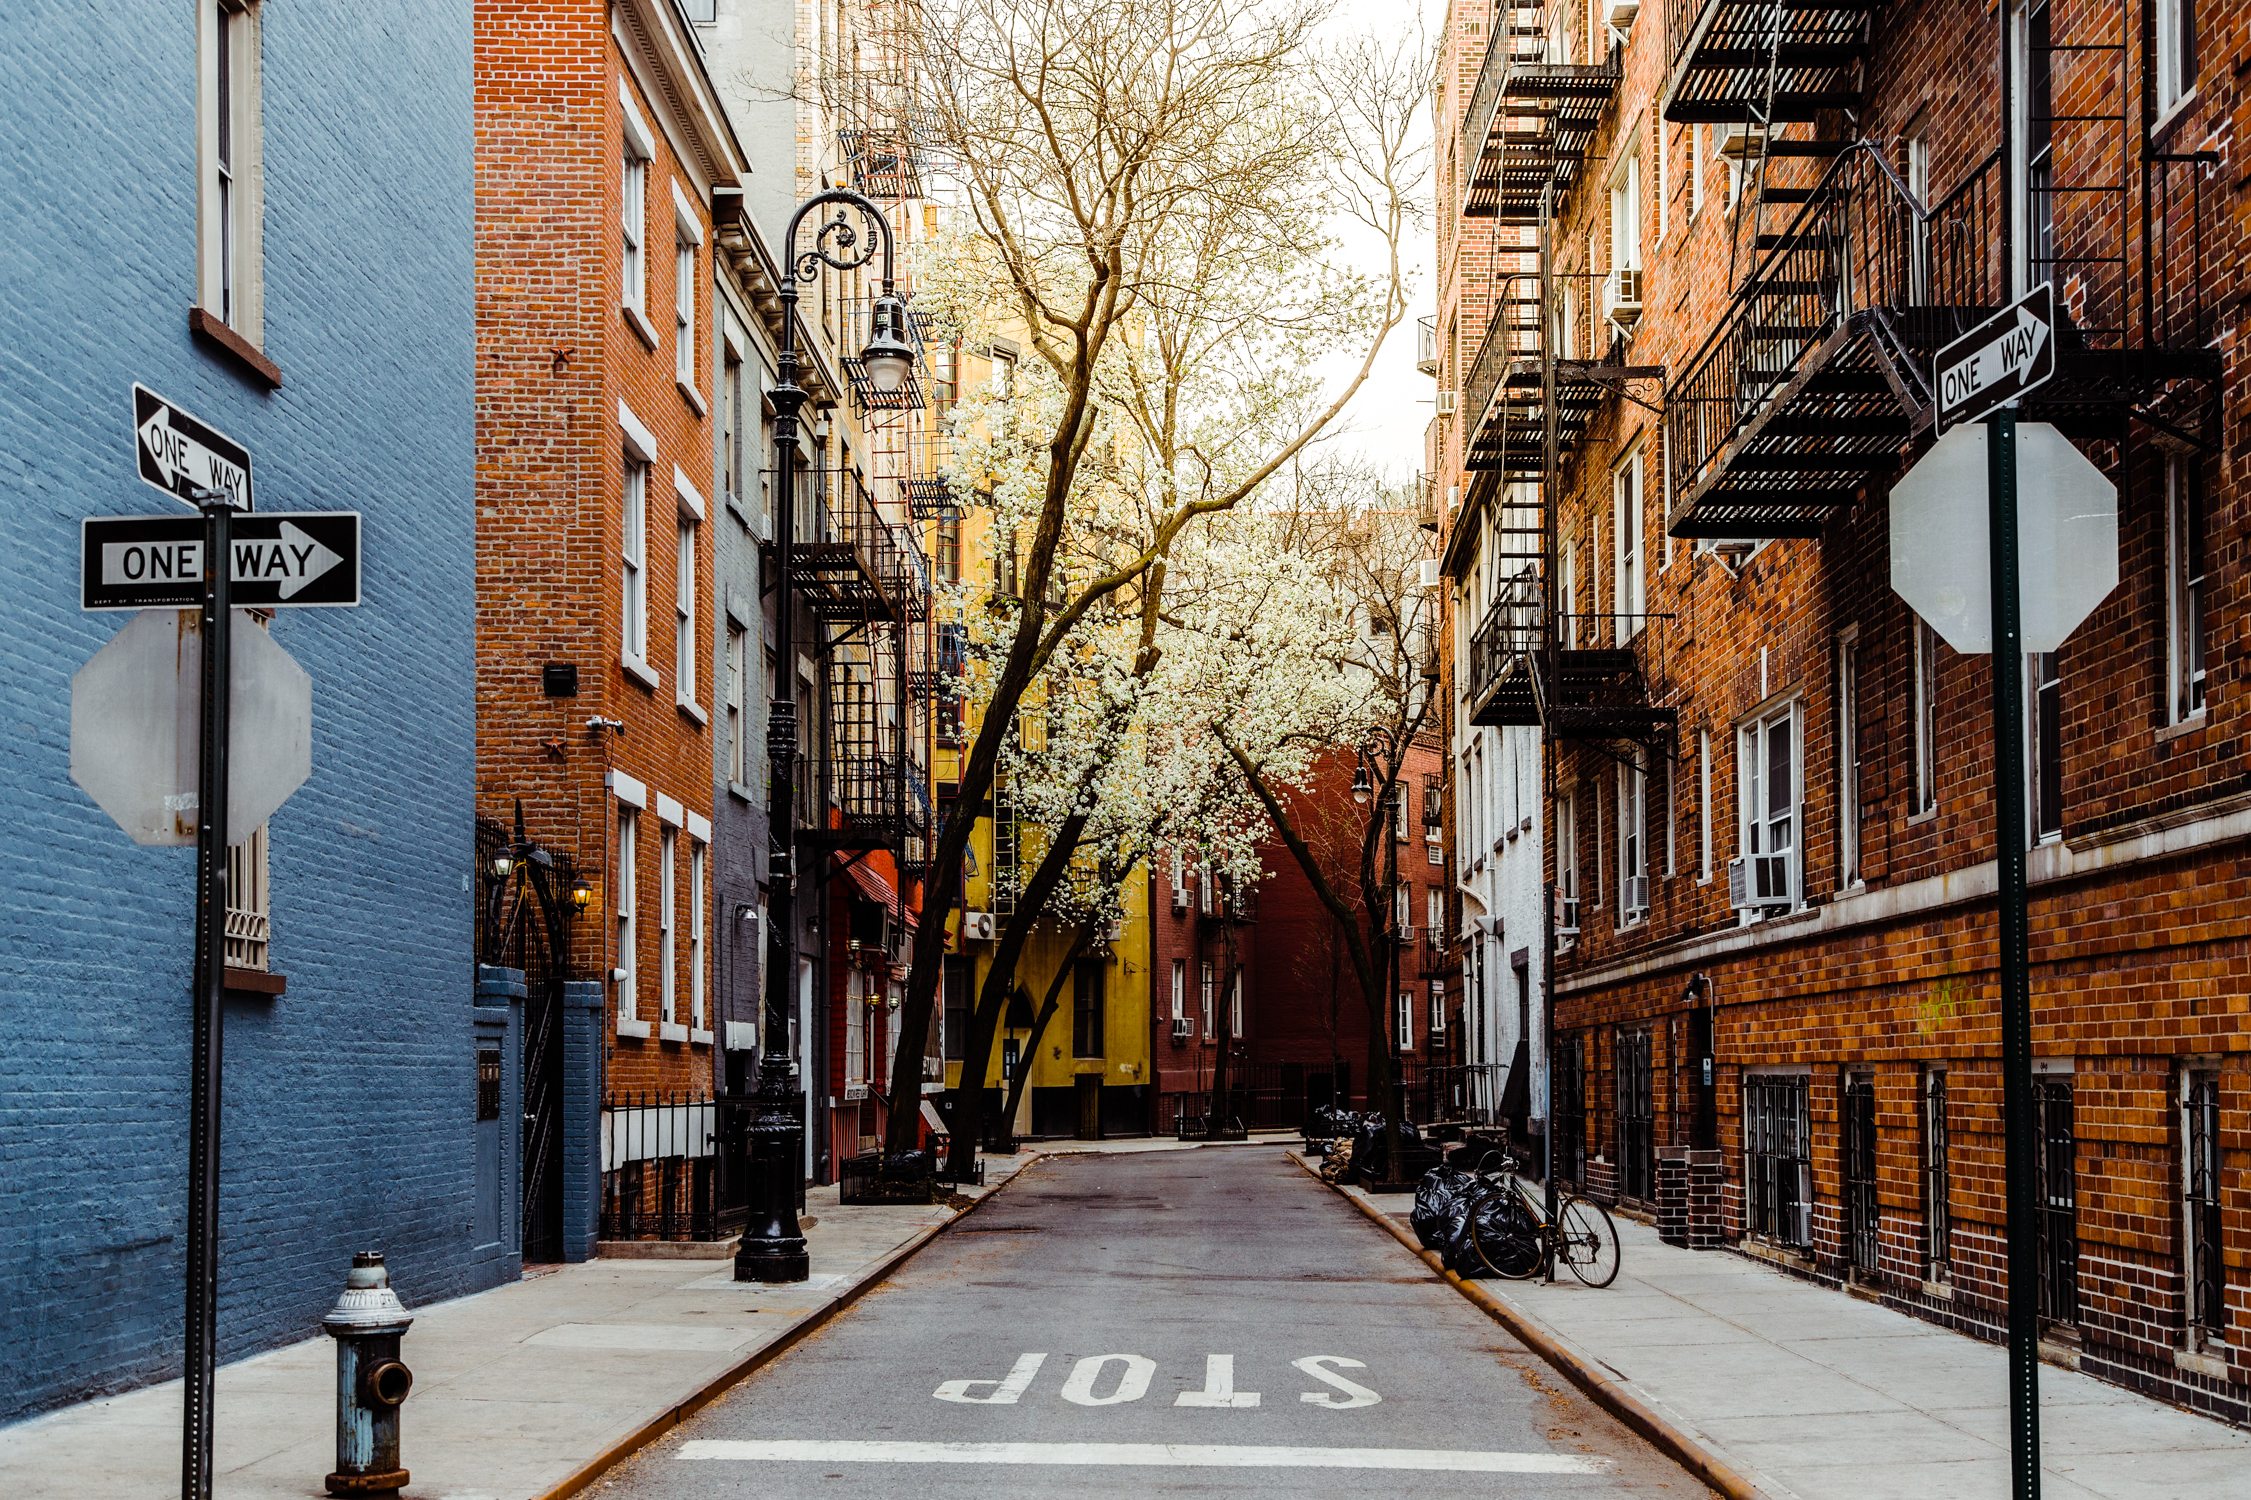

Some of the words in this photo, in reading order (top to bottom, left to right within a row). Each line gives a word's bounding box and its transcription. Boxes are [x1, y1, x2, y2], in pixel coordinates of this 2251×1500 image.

[1946, 356, 1981, 405] ONE
[2001, 319, 2037, 373] WAY
[151, 423, 190, 475] ONE
[209, 455, 242, 502] WAY
[123, 545, 197, 580] ONE
[235, 543, 316, 577] WAY
[931, 1352, 1383, 1409] STOP
